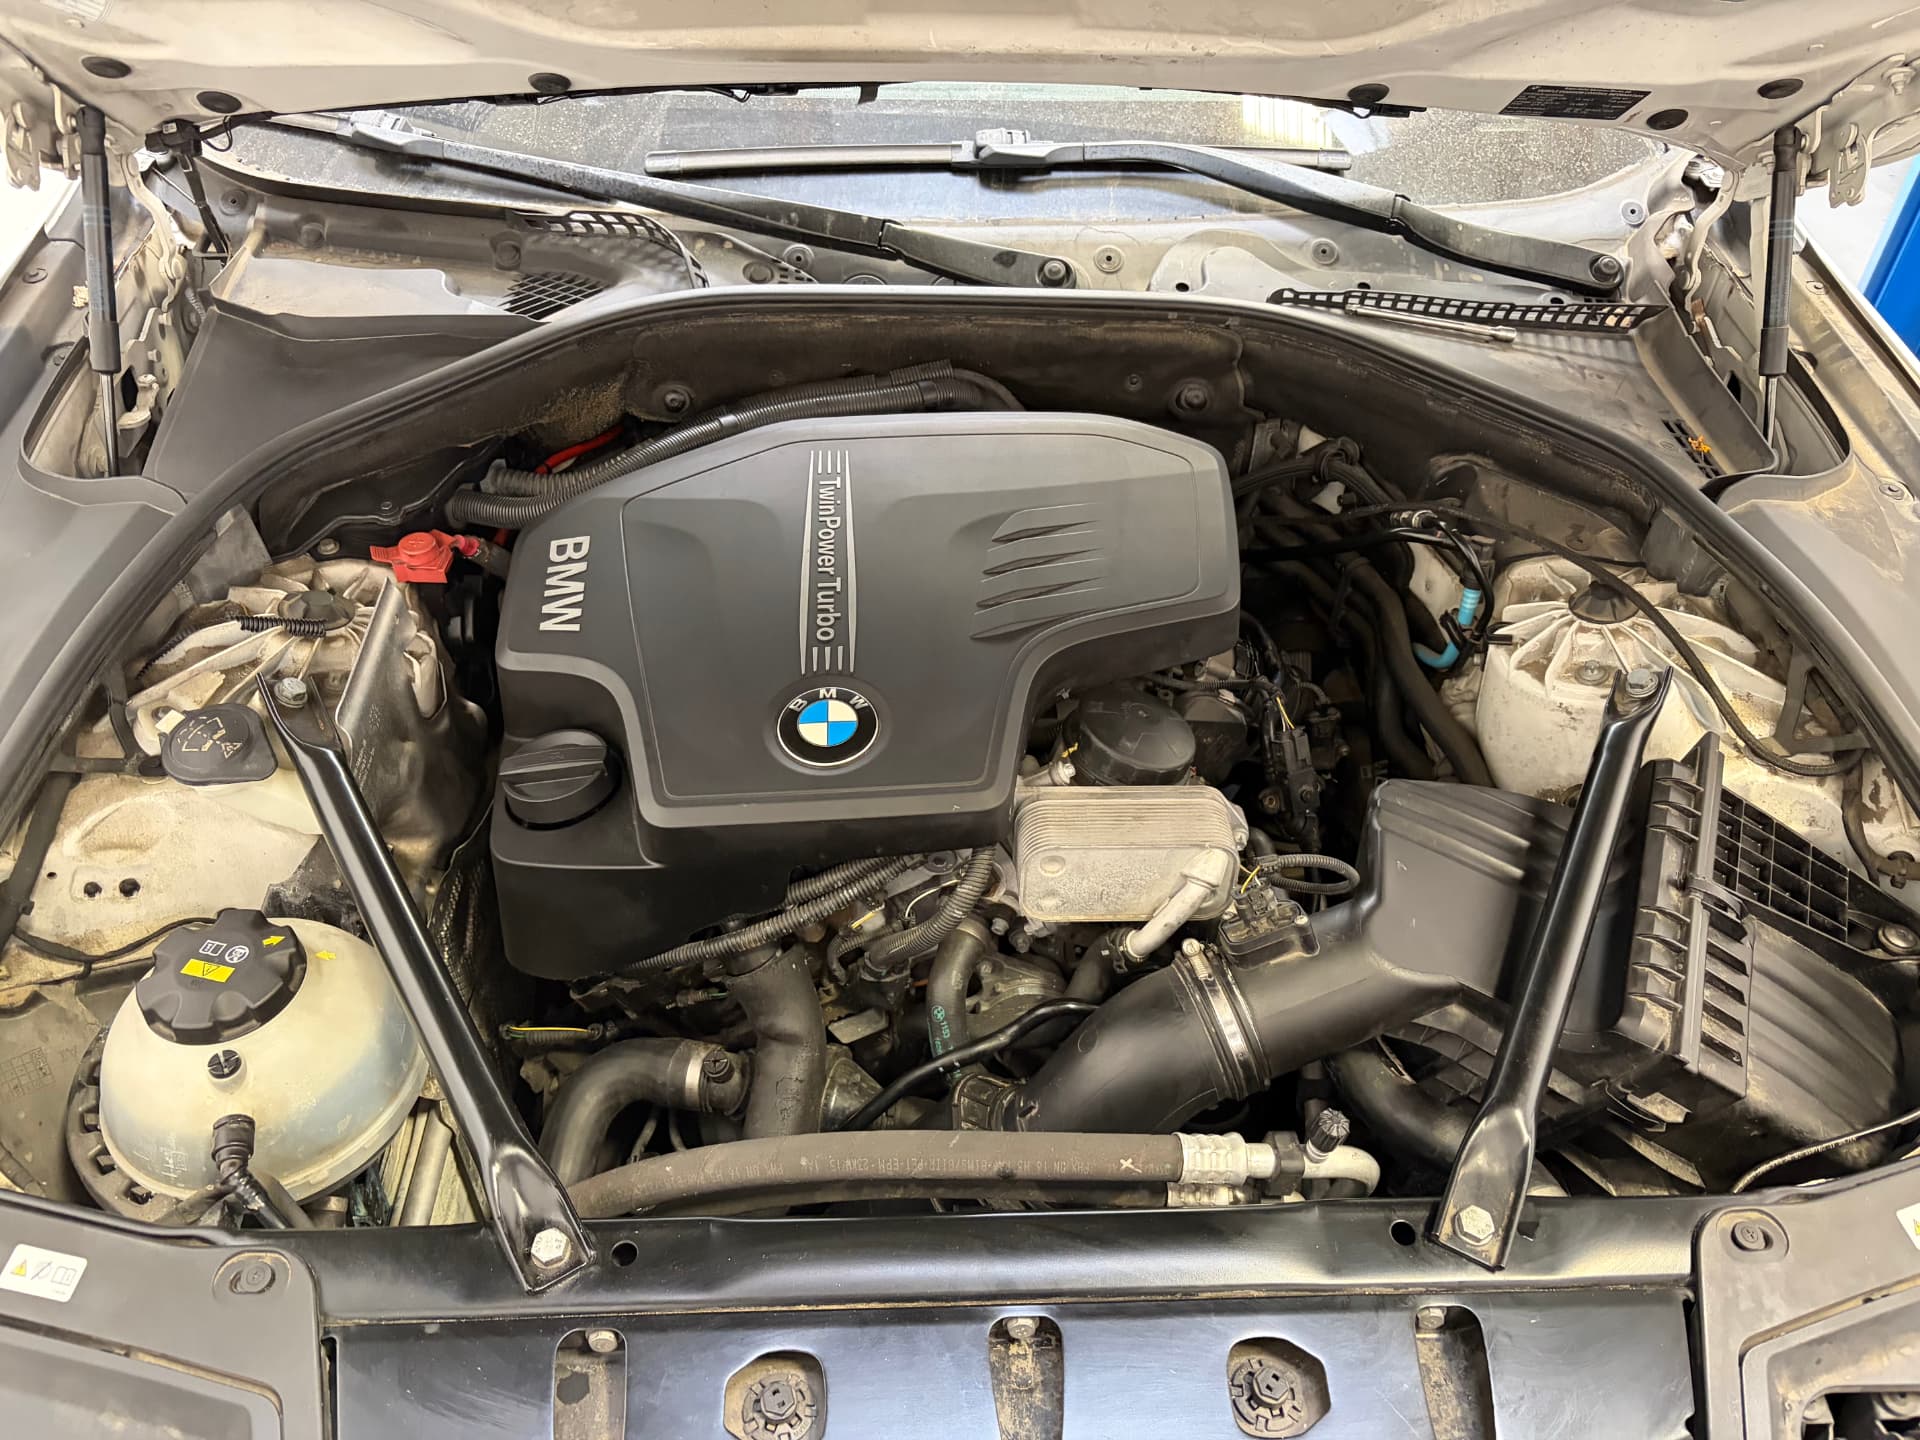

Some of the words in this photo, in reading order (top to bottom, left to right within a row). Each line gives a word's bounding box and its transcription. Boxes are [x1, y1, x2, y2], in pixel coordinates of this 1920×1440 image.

[816, 476, 841, 576] TwinPower
[539, 535, 591, 632] BMW
[815, 577, 842, 641] Turbo
[789, 688, 869, 712] BMW
